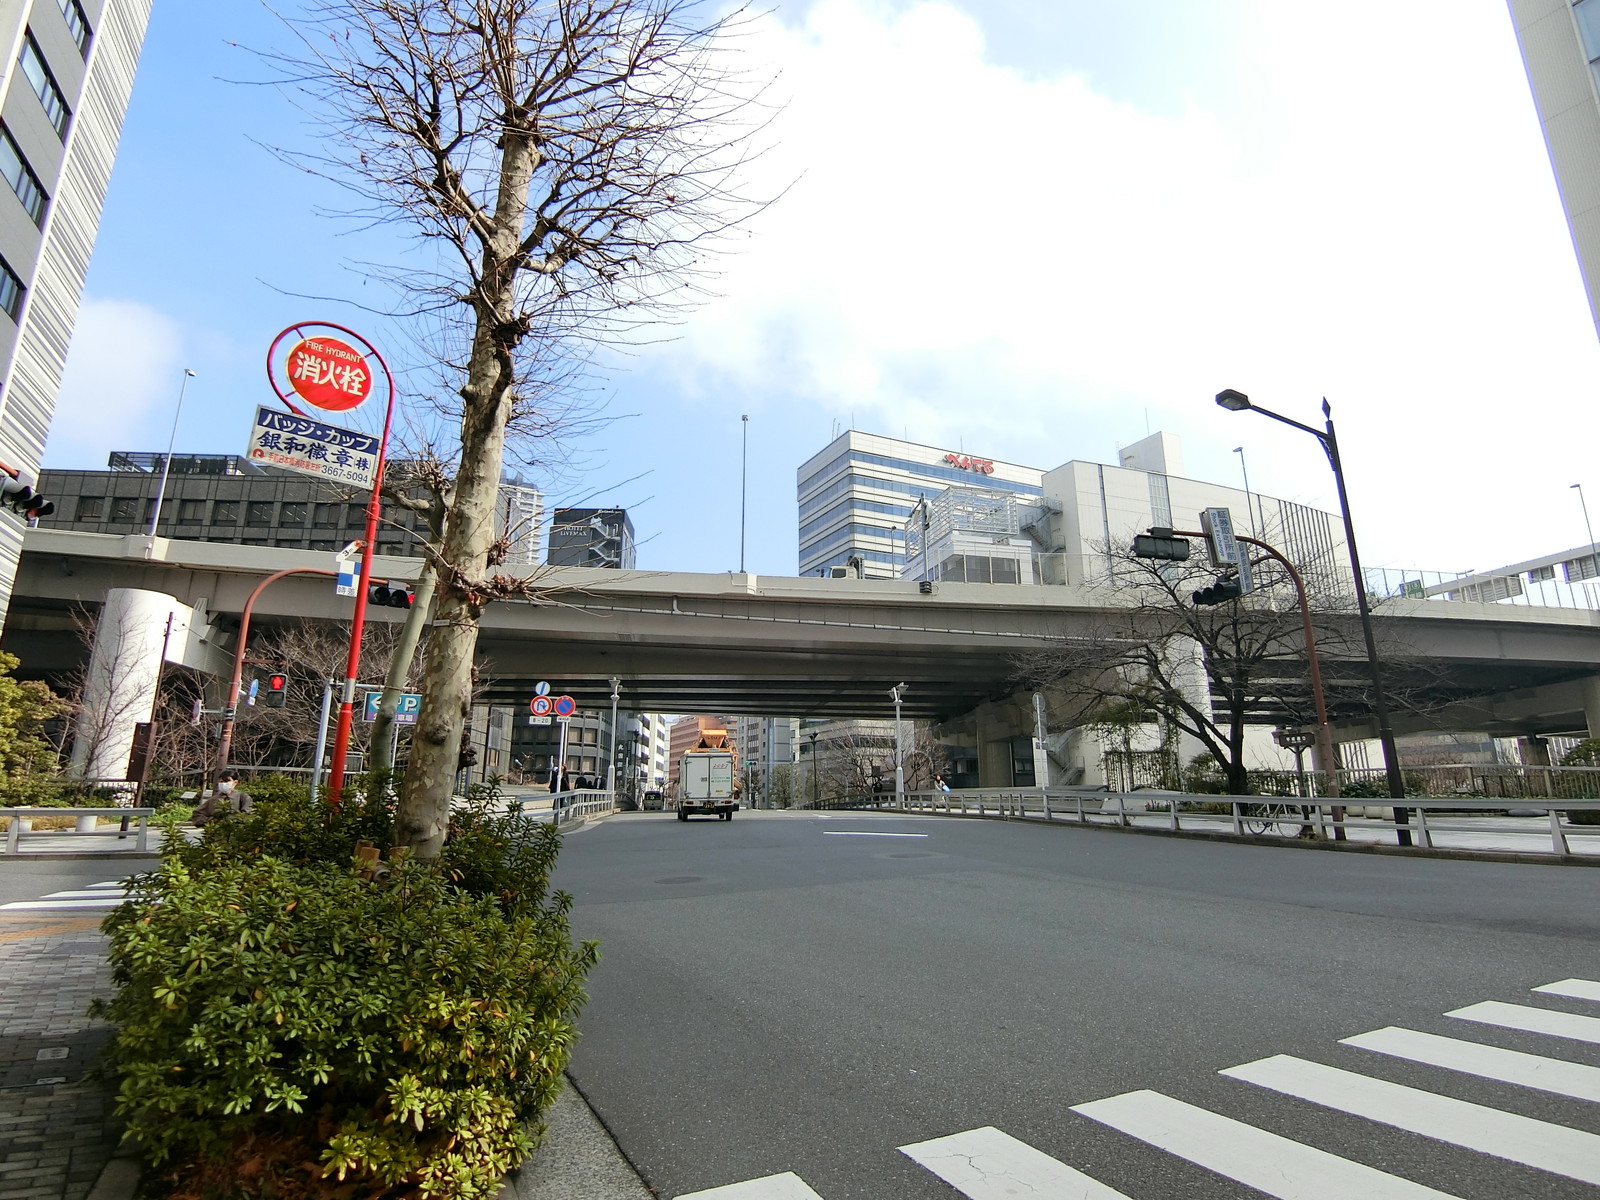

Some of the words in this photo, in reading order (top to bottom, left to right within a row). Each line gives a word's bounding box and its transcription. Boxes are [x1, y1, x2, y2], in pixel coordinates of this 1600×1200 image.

[305, 340, 324, 353] FIRE
[325, 347, 362, 364] HYDRANT
[293, 351, 367, 396] 消火栓
[262, 413, 373, 450] バッジ・カップ
[321, 465, 368, 484] 3667-5094
[1210, 512, 1219, 528] Stock
[1215, 529, 1225, 557] Exchange
[1216, 510, 1237, 561] 証券取引所前
[405, 697, 417, 712] P
